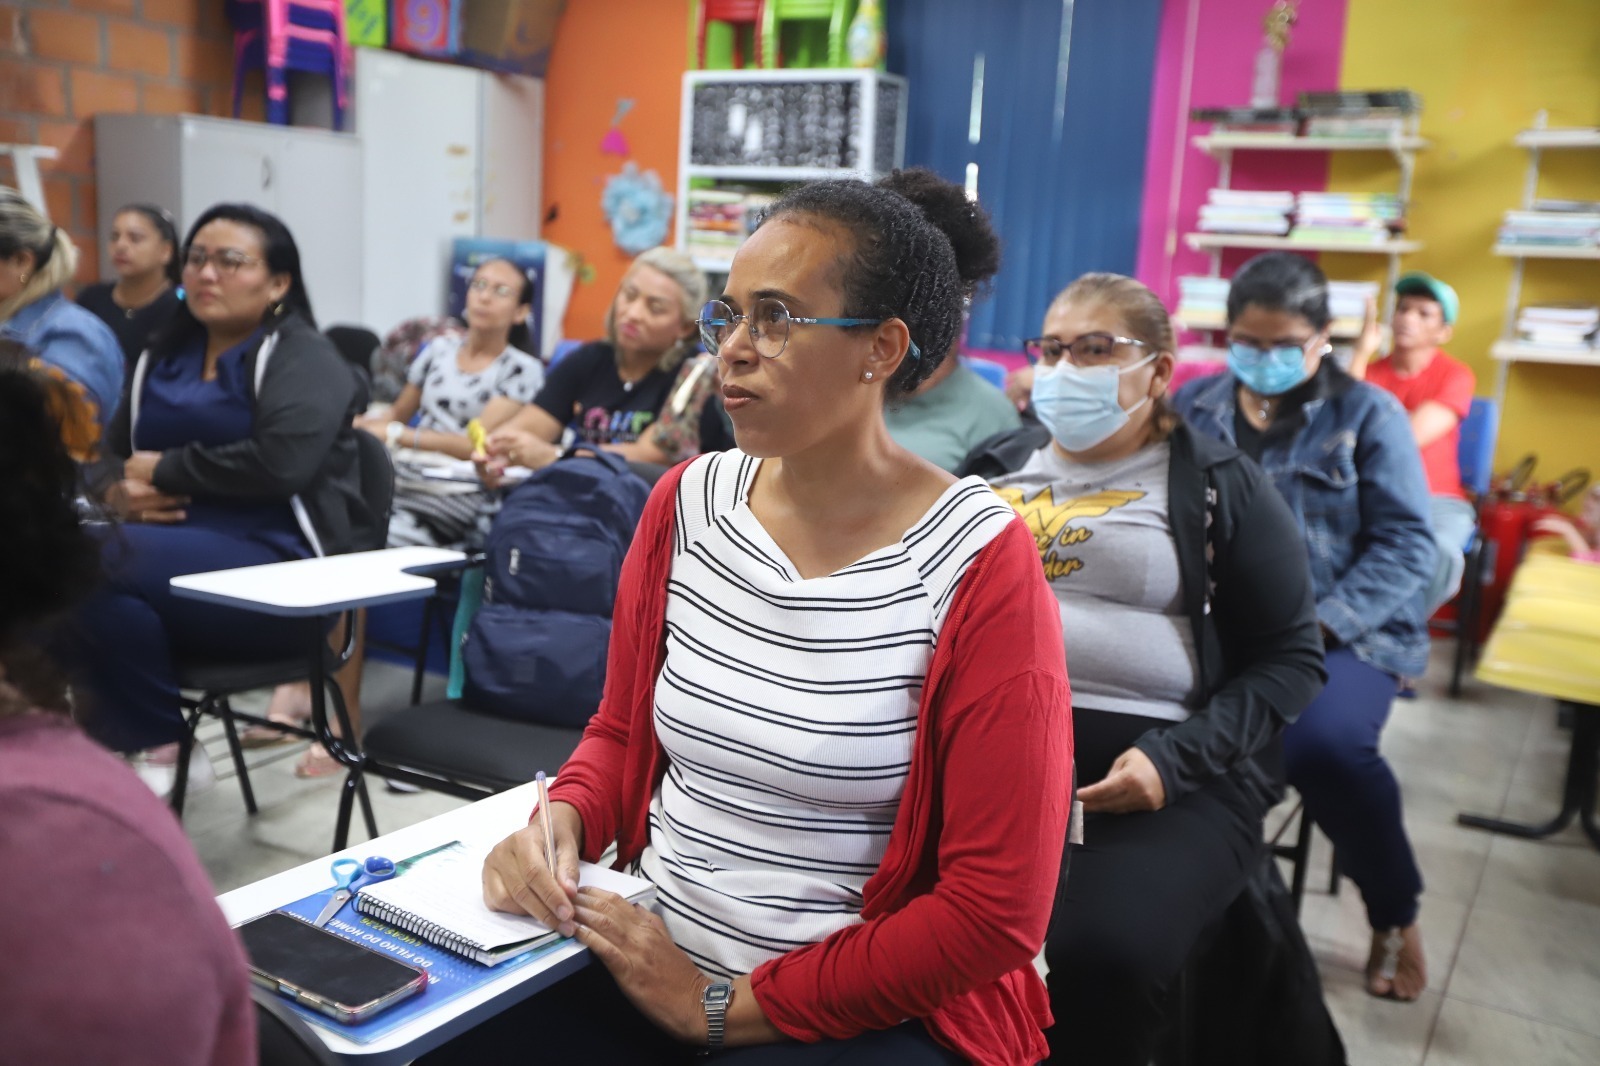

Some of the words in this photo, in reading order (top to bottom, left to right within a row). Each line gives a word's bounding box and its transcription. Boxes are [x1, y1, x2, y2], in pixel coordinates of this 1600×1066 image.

[1059, 526, 1093, 547] in
[1043, 550, 1084, 582] der
[361, 933, 382, 944] DO
[379, 941, 415, 959] FILHO
[412, 956, 433, 968] DO
